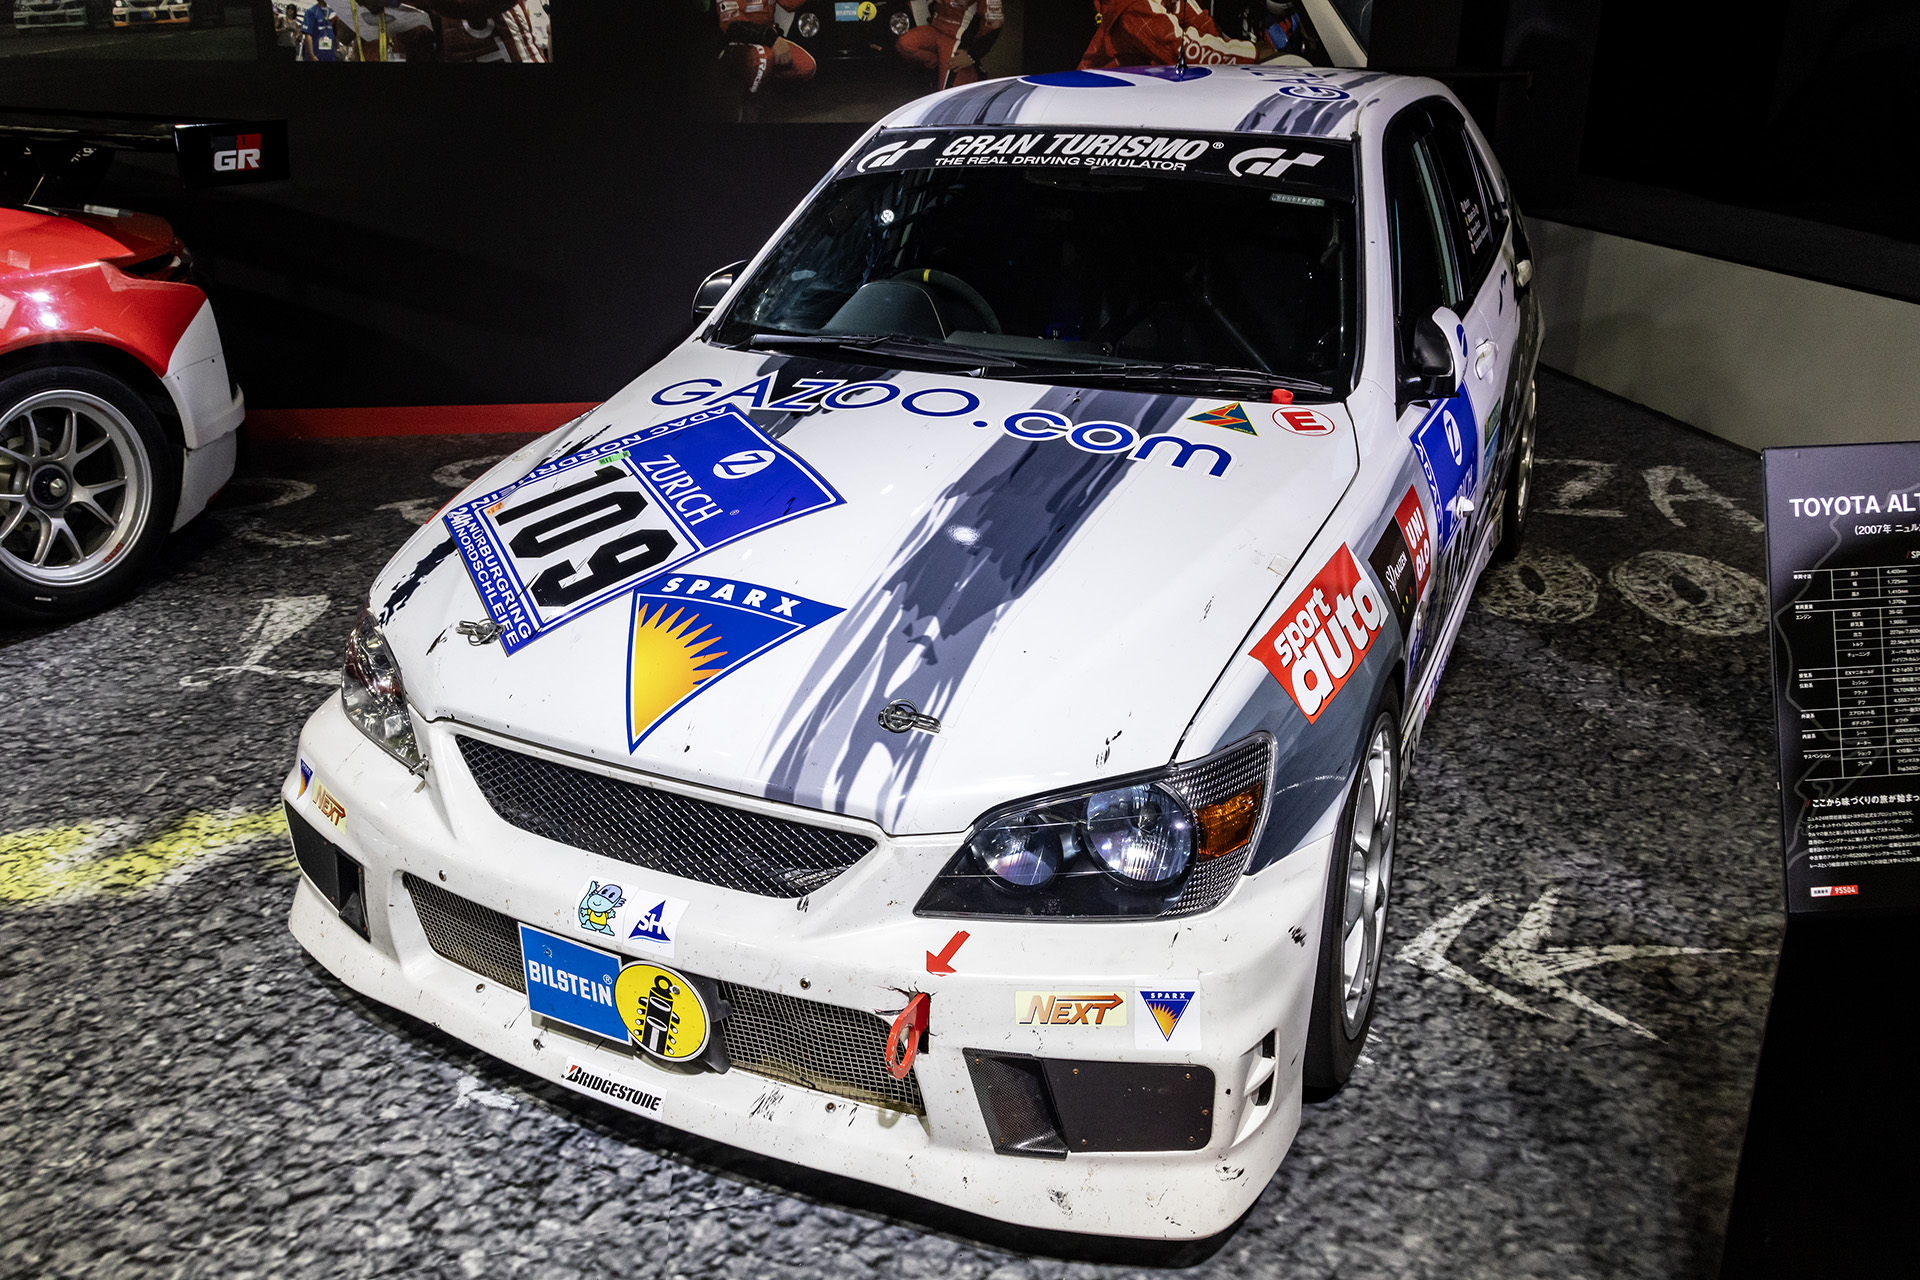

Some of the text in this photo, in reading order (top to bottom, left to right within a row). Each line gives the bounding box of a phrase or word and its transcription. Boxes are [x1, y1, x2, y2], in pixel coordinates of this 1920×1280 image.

[213, 148, 260, 172] GR
[935, 156, 1186, 172] THE REAL DRIVING SIMULATOR
[943, 135, 1036, 156] GRAN
[647, 405, 728, 436] ADAC
[651, 377, 1233, 478] GAZOO.com
[639, 453, 723, 528] ZURICH
[1789, 495, 1881, 517] TOYOTA
[496, 465, 678, 608] 109
[1405, 506, 1426, 549] UNI
[466, 521, 532, 641] NÜRBURGRING
[1416, 538, 1431, 581] QLO
[455, 526, 521, 648] NORDSCHLEIFE
[662, 576, 804, 619] SPARX
[1274, 588, 1331, 668] sport
[1290, 578, 1387, 716] auto
[313, 784, 346, 827] NEXT
[1019, 993, 1123, 1026] NEXT
[1150, 991, 1186, 1000] SPARX
[562, 1065, 662, 1112] BRIDGESTONE
